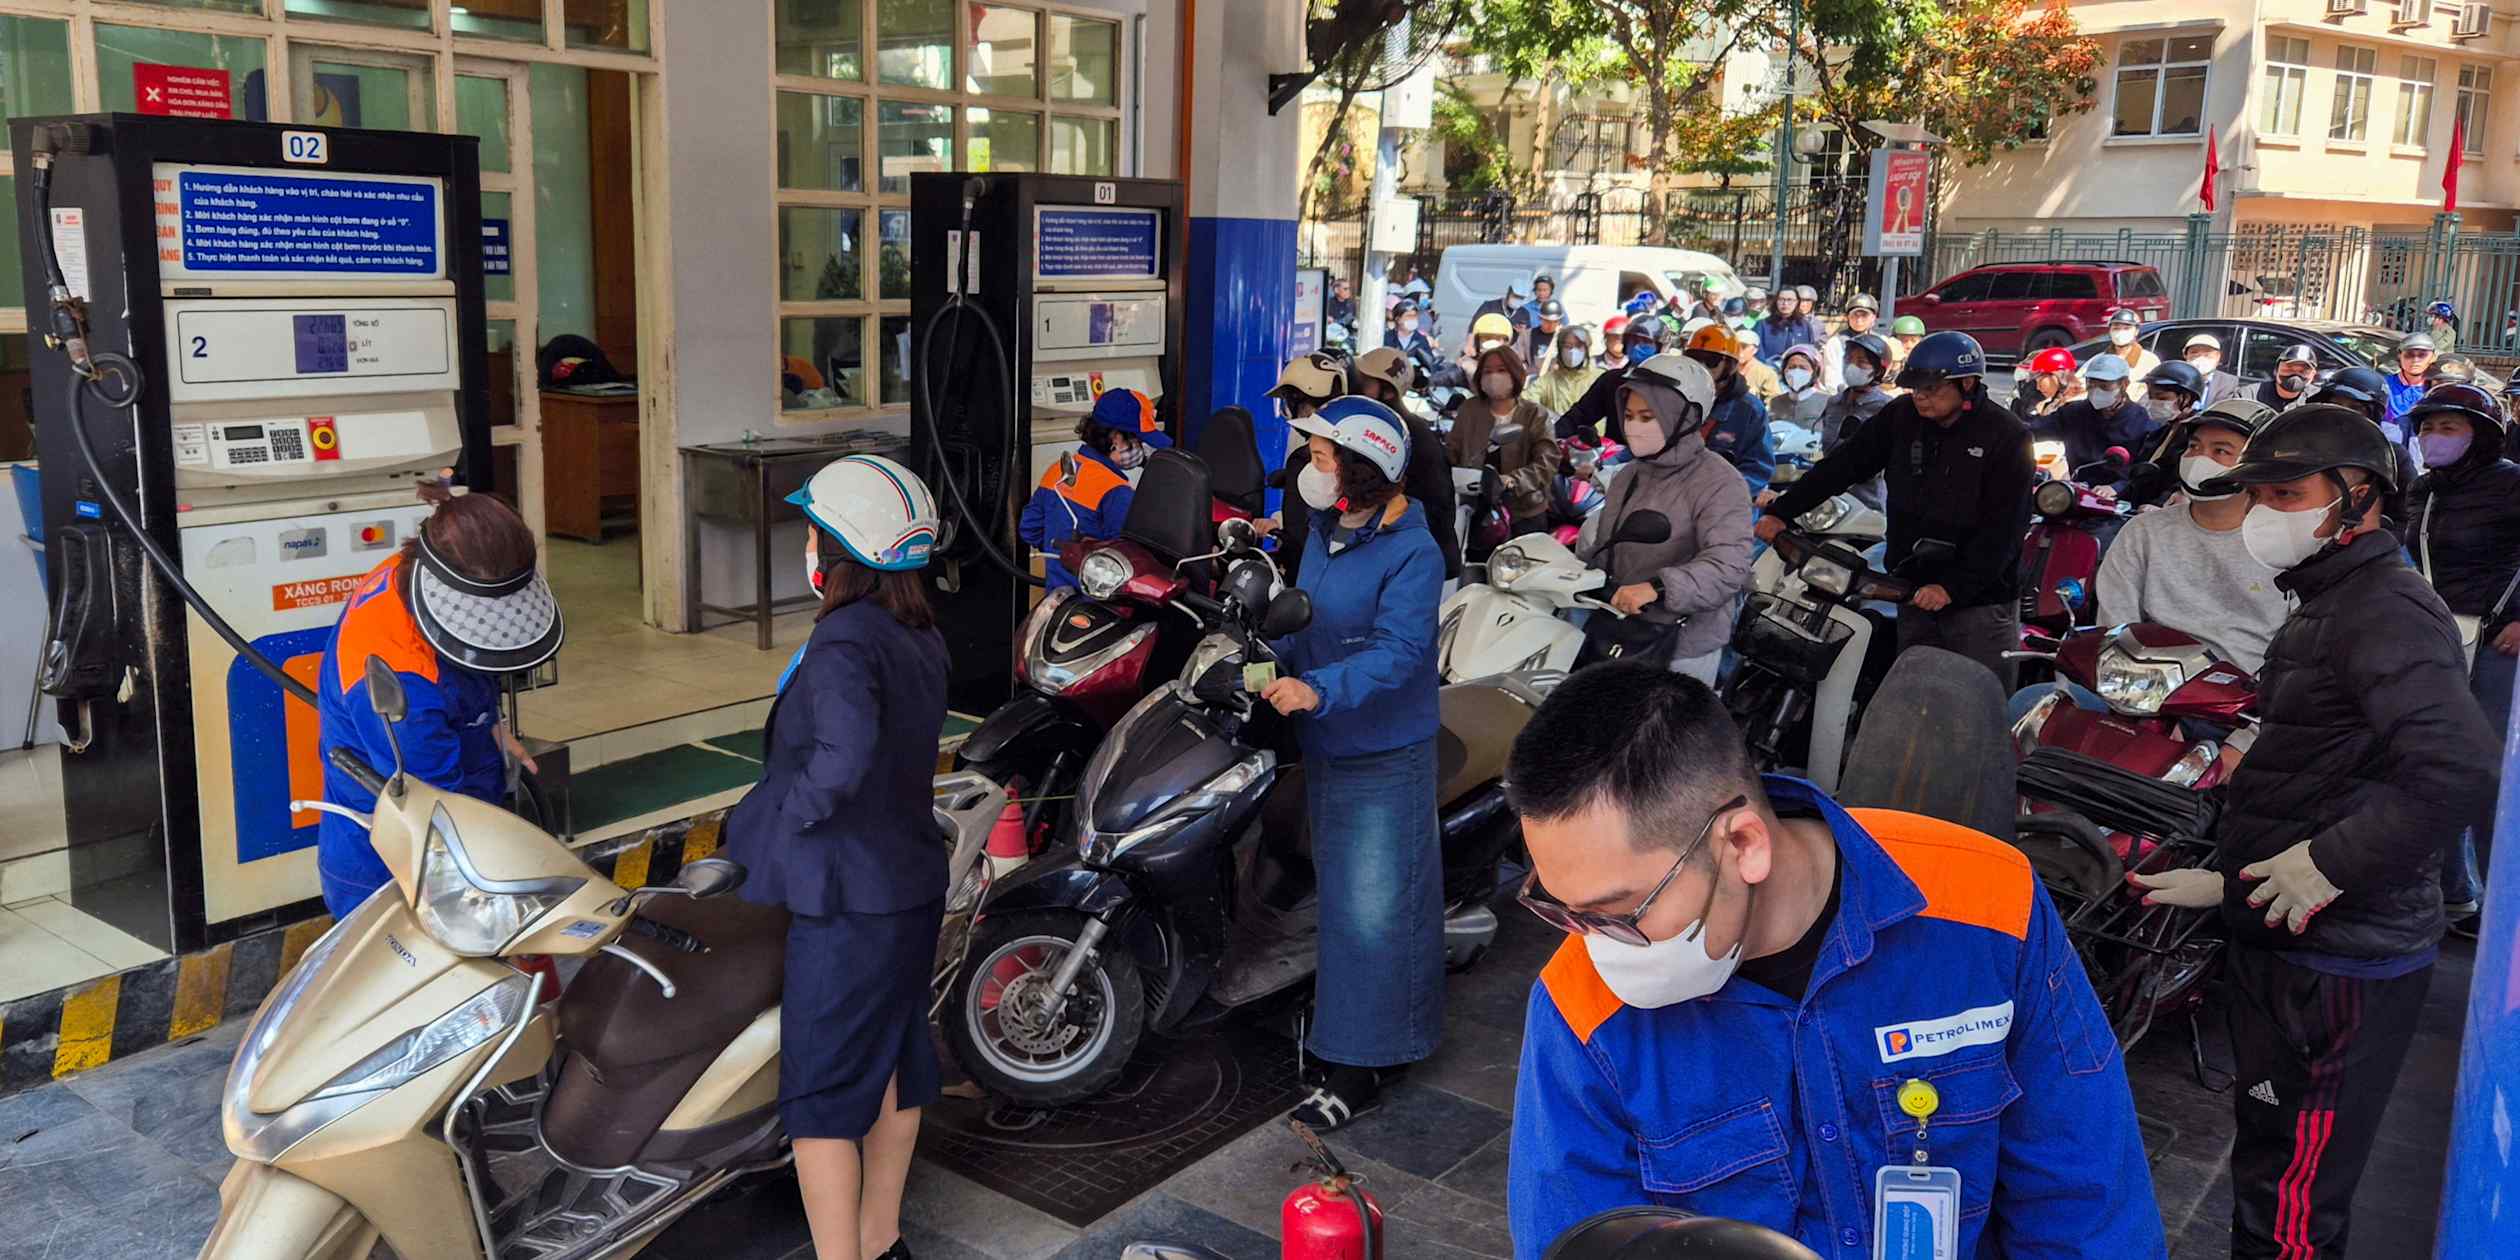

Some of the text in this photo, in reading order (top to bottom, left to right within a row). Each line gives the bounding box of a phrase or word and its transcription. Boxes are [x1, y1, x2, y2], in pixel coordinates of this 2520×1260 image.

[290, 136, 320, 158] 02
[184, 182, 192, 191] 1.
[223, 184, 238, 193] dẫn
[239, 185, 263, 194] khách
[265, 186, 284, 196] hàng
[354, 190, 362, 198] và
[364, 191, 376, 199] xác
[378, 191, 395, 201] nhận
[1100, 186, 1111, 200] 01
[194, 197, 209, 206] của
[210, 197, 234, 206] khách
[185, 210, 193, 219] 2.
[212, 211, 236, 220] khách
[238, 212, 257, 222] hàng
[259, 213, 272, 221] xác
[274, 213, 293, 223] nhận
[312, 215, 329, 223] hình
[361, 217, 379, 227] đang
[195, 225, 215, 234] Bơm
[217, 225, 236, 236] hàng
[273, 227, 290, 236] theo
[337, 229, 359, 237] khách
[213, 239, 237, 248] khách
[239, 240, 258, 250] hàng
[275, 241, 294, 250] nhận
[383, 243, 394, 251] khi
[197, 253, 218, 262] Thực
[219, 253, 236, 263] hiện
[238, 254, 260, 262] thanh
[262, 254, 279, 262] toán
[306, 255, 324, 264] nhận
[383, 257, 404, 265] khách
[1046, 318, 1050, 332] 1
[192, 336, 207, 357] 2
[284, 582, 327, 599] XĂNG
[296, 596, 322, 607] TCCS
[1915, 1014, 2010, 1043] PETROLIMEX
[2248, 1088, 2279, 1106] adidas
